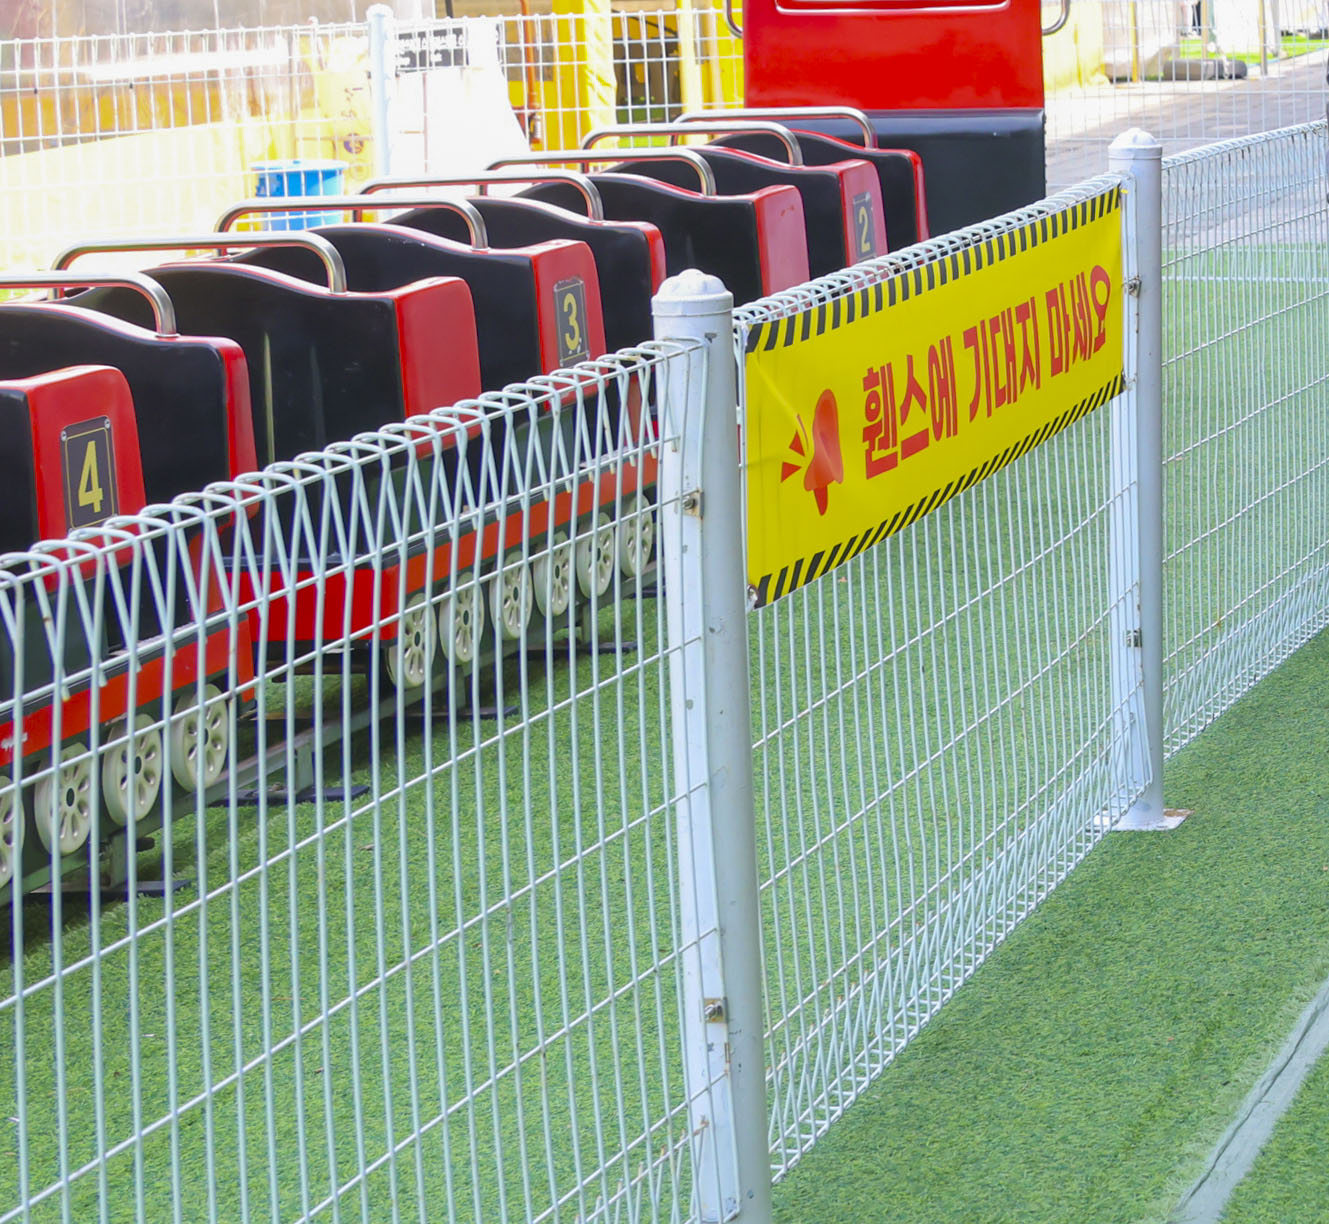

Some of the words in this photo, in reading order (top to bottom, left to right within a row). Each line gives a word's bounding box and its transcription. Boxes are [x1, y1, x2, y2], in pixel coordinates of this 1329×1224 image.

[859, 206, 871, 253] 2
[563, 292, 580, 351] 3
[862, 335, 959, 480] 휀스에
[961, 296, 1042, 424] 기대지
[1045, 264, 1112, 378] 마세요
[78, 440, 103, 513] 4
